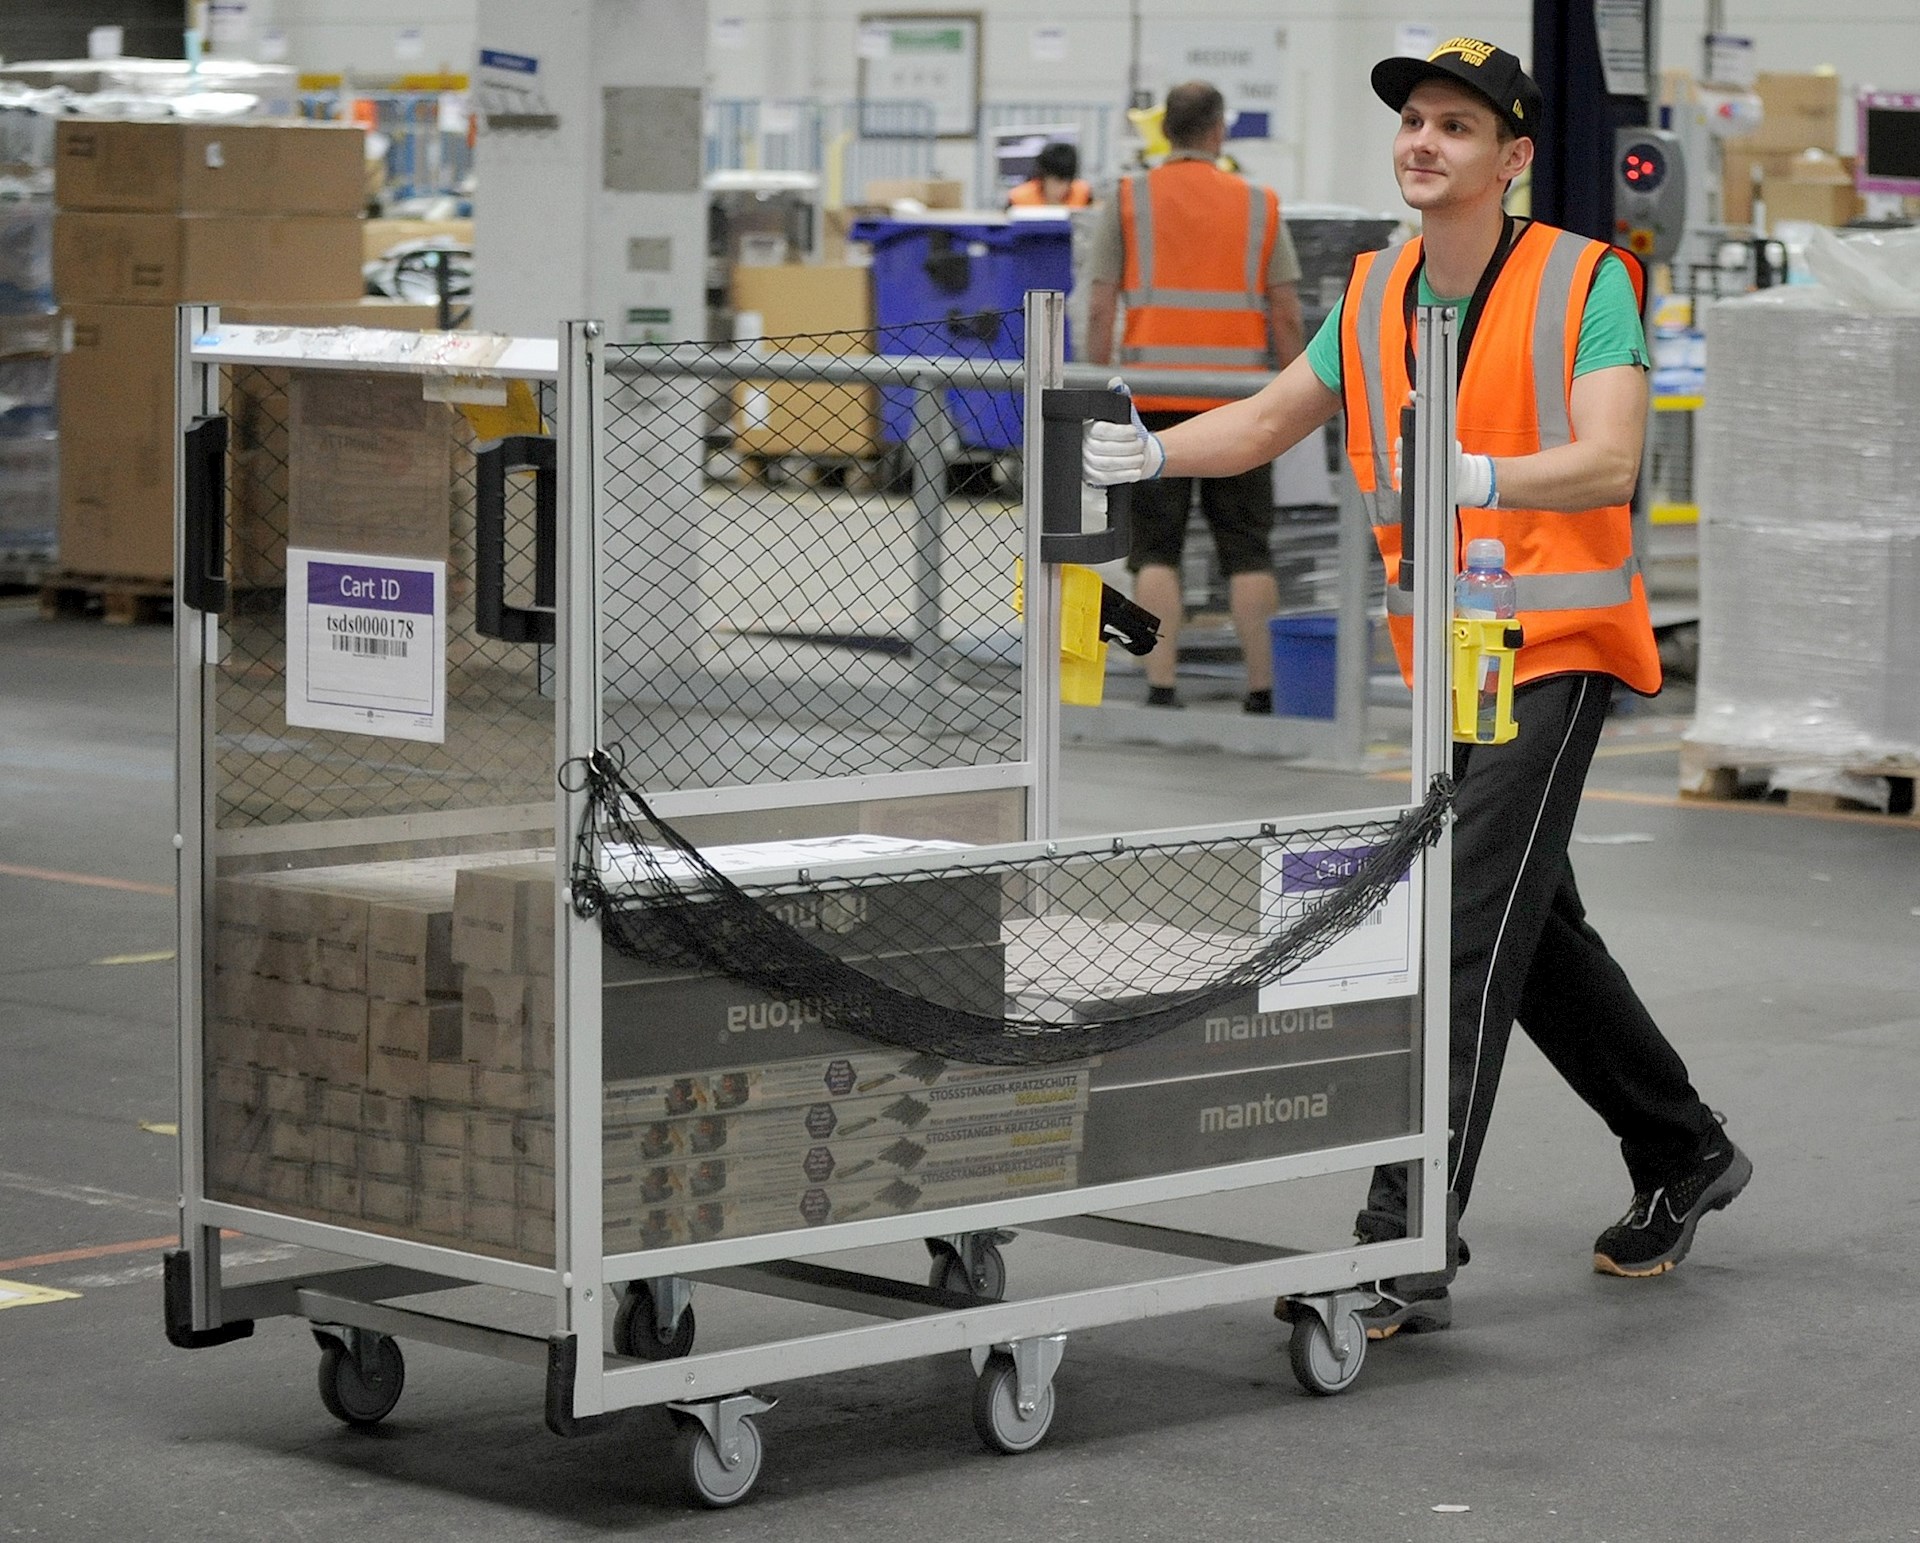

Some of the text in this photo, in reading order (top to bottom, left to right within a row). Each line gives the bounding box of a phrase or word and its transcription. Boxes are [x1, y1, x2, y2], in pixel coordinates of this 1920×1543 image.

[1459, 51, 1484, 67] 1909
[340, 575, 401, 601] Cart ID
[326, 613, 415, 640] tsds0000178
[1315, 858, 1352, 881] Cart
[1205, 1005, 1334, 1044] mantona
[928, 1075, 1078, 1102] STOSSSTANGEN-KRATZSCHUTZ
[1200, 1093, 1329, 1134] mantona
